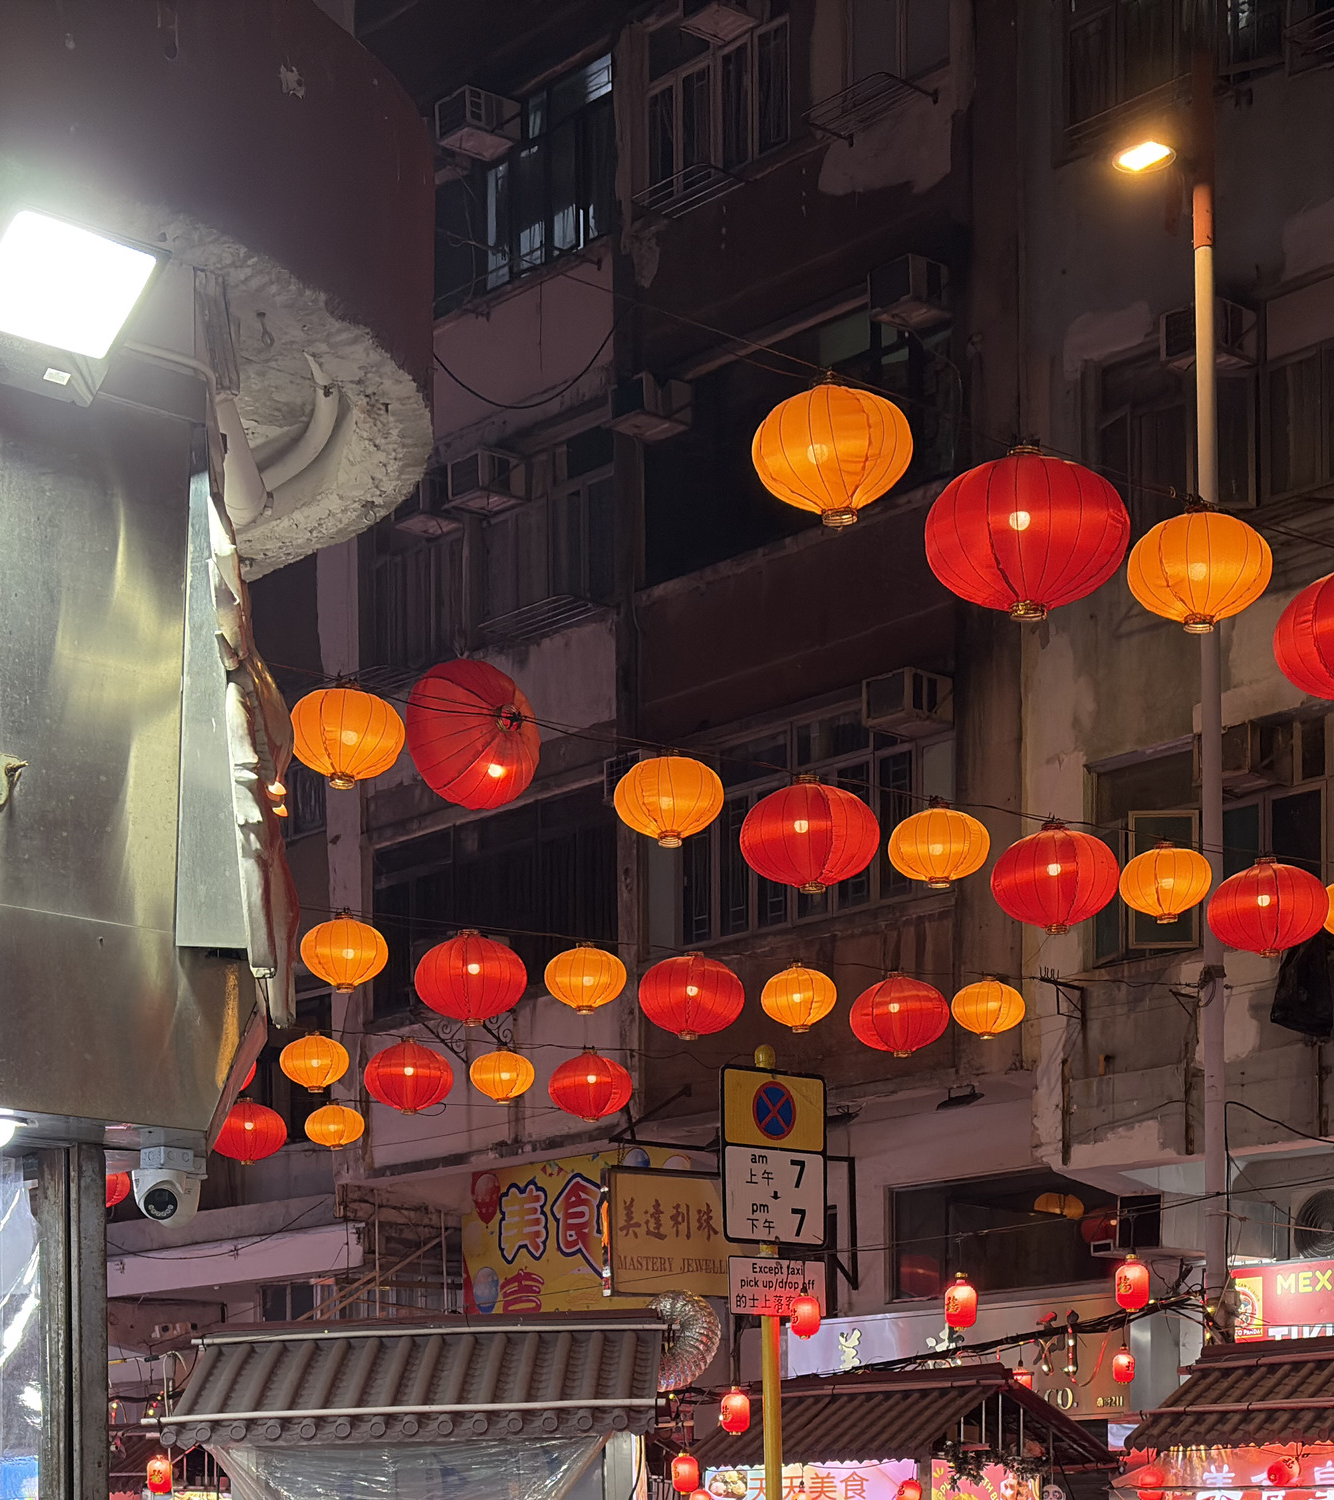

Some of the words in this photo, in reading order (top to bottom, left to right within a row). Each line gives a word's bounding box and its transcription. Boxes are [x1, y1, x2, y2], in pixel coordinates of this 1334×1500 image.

[746, 1168, 774, 1186] 上午
[750, 1153, 768, 1164] am
[790, 1159, 806, 1189] 7
[746, 1217, 775, 1235] 下午
[752, 1202, 769, 1215] pm
[791, 1208, 806, 1237] 7
[618, 1254, 675, 1272] MASTERY
[680, 1256, 729, 1275] JEWELL
[752, 1262, 783, 1276] Except
[787, 1262, 803, 1275] taxi
[740, 1277, 759, 1289] pick
[762, 1279, 799, 1291] up/drop
